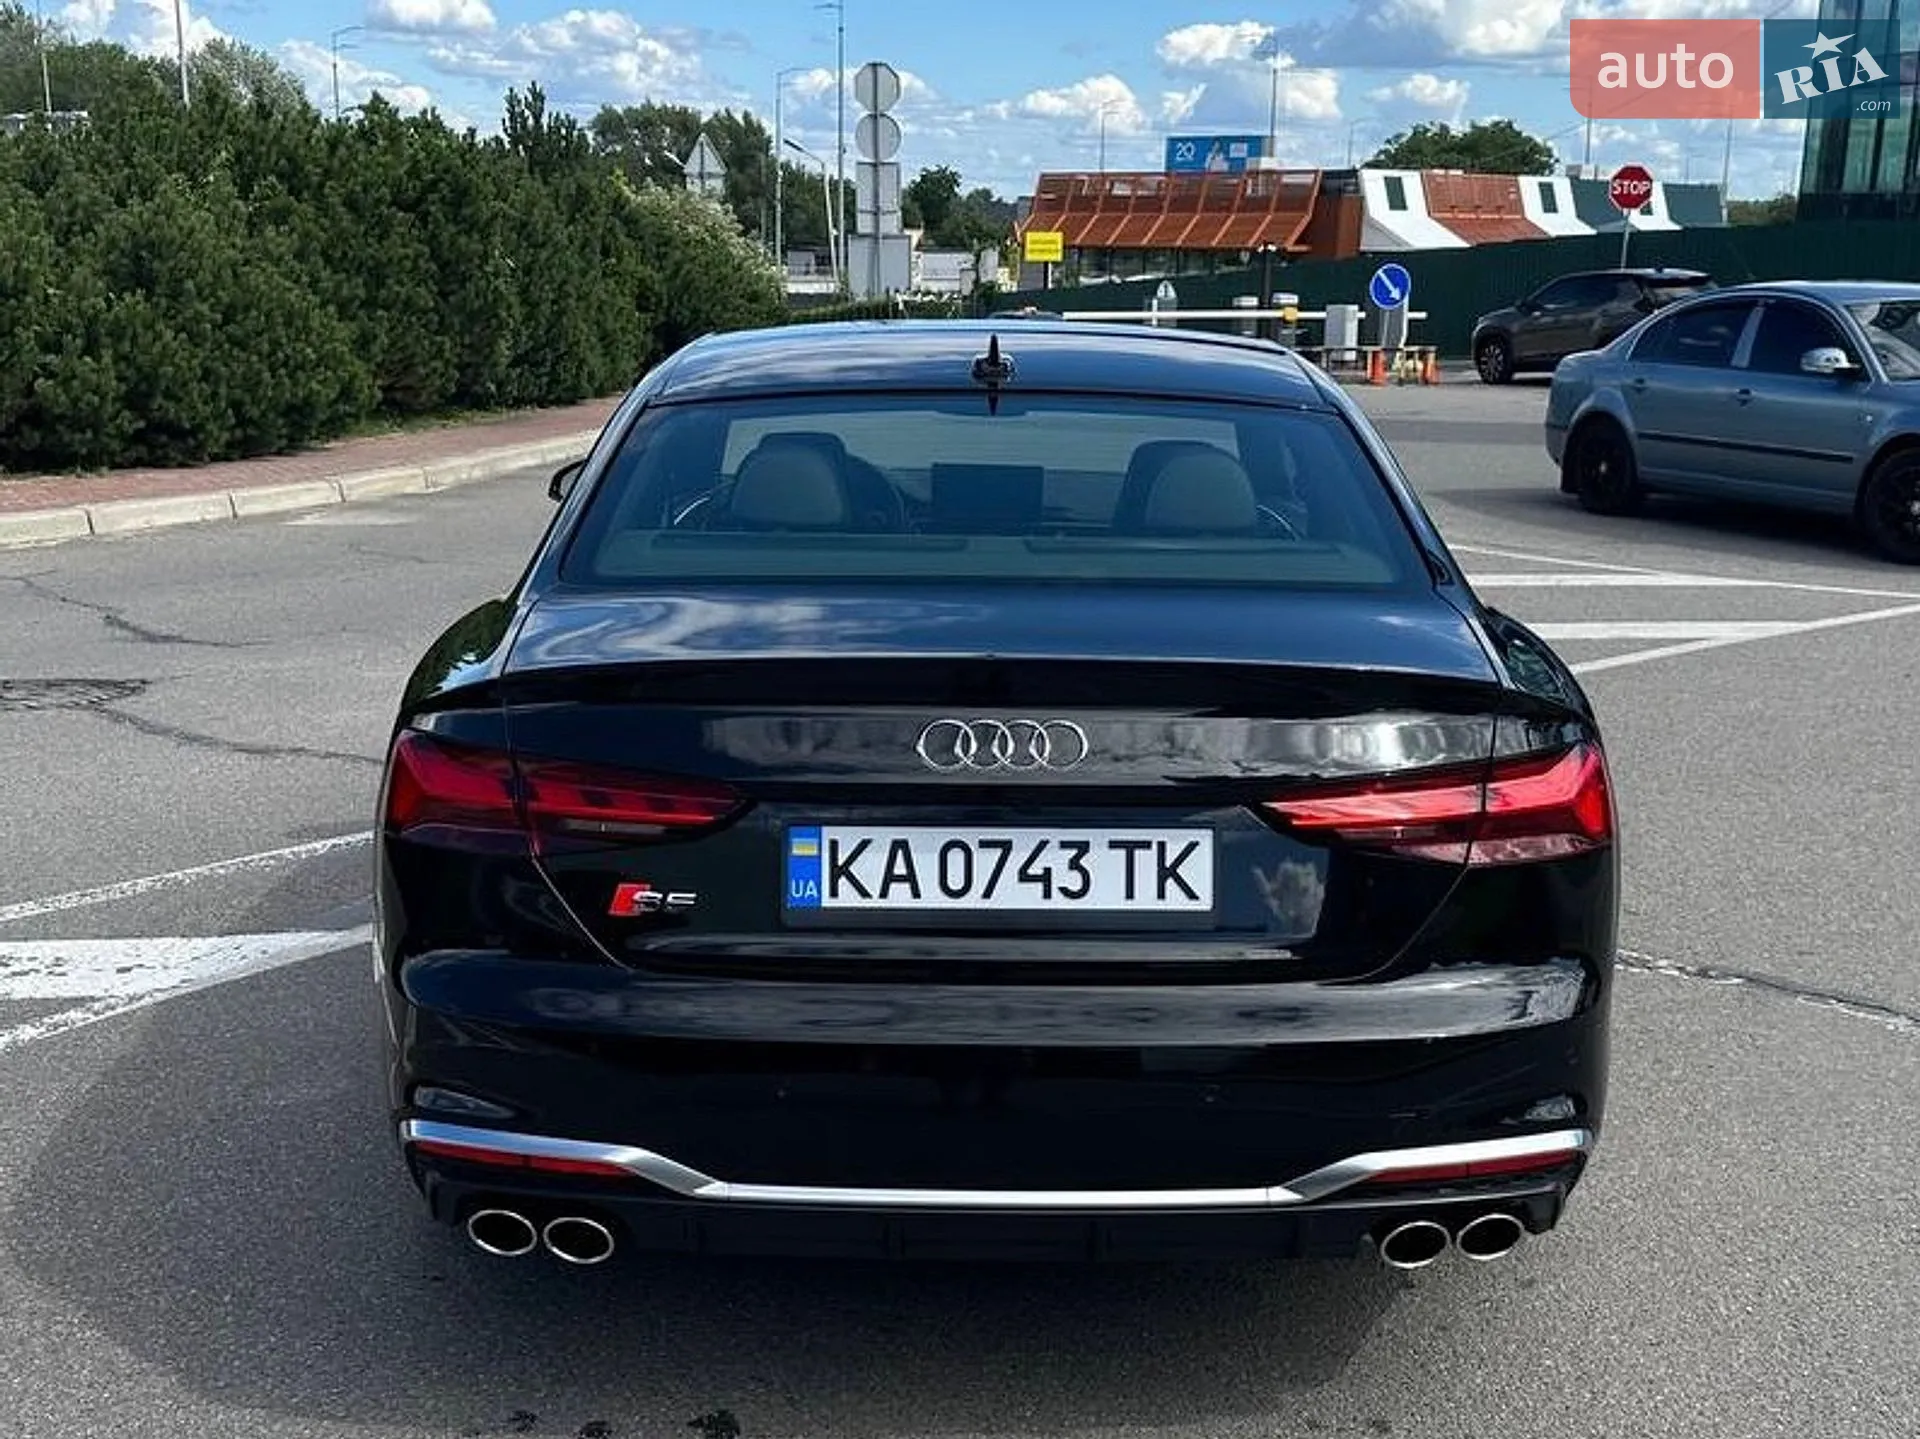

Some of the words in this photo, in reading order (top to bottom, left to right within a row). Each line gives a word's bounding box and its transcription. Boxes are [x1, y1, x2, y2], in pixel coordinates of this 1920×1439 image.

[1612, 180, 1651, 195] STOP
[828, 838, 922, 899] KA
[939, 839, 1092, 900] 0743
[1108, 840, 1200, 900] TK
[791, 879, 818, 898] UA
